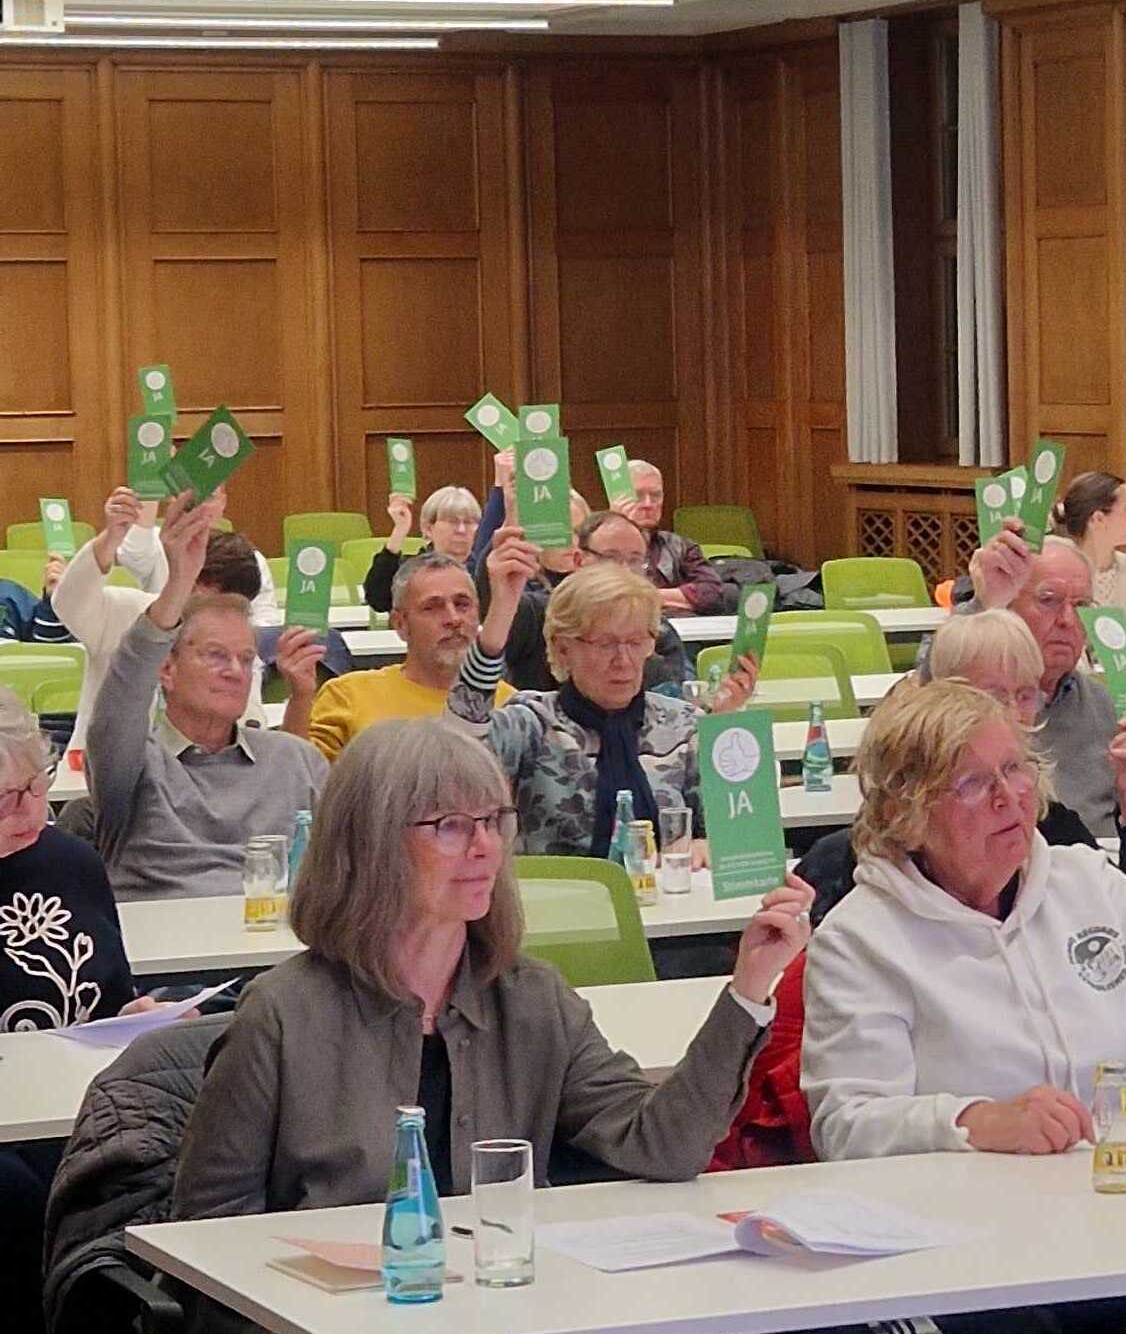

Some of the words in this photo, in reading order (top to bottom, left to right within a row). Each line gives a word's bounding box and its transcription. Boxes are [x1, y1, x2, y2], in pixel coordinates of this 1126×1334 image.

[532, 485, 553, 504] JA
[300, 579, 316, 595] JA
[728, 789, 754, 819] JA
